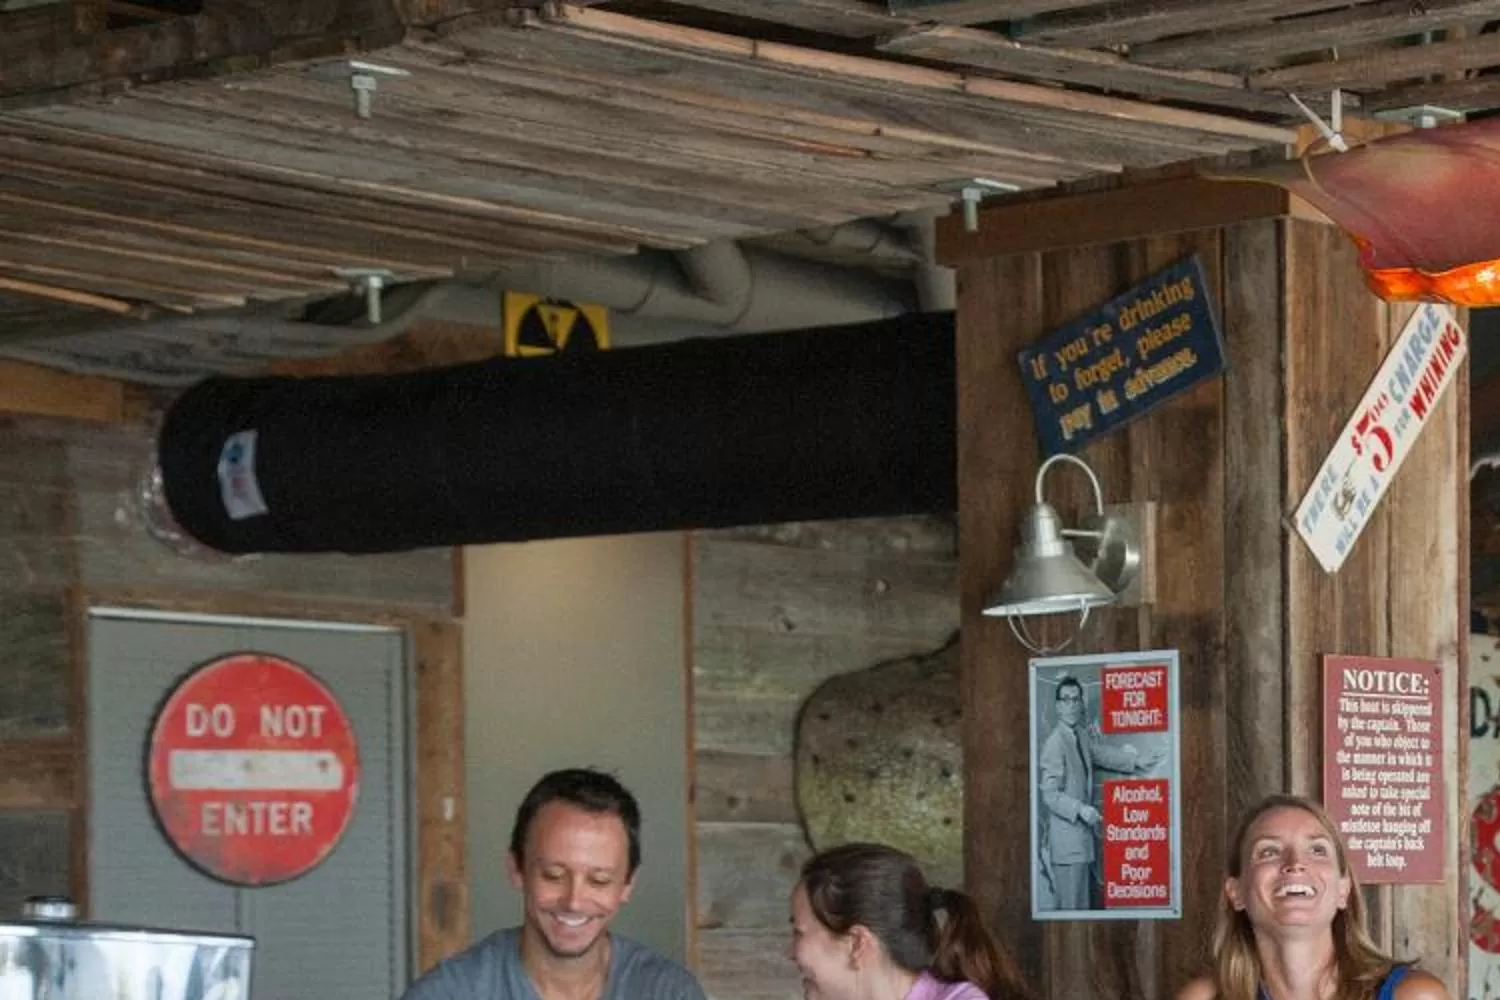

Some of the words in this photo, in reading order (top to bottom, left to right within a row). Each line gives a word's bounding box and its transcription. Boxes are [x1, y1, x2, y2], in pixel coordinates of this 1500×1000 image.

[1054, 323, 1113, 371] you're
[1119, 276, 1195, 331] drinking
[1049, 383, 1069, 403] to
[1073, 348, 1131, 390] forget,
[1136, 313, 1192, 360] please
[1388, 304, 1440, 405] CHARGE
[1409, 321, 1461, 421] WHINING
[1060, 402, 1092, 440] pay
[1096, 389, 1120, 414] in
[1303, 463, 1338, 535] THERE
[1105, 671, 1162, 689] FORECAST
[1343, 668, 1430, 695] NOTICE:
[1123, 690, 1146, 707] FOR
[1338, 698, 1358, 713] This
[1382, 701, 1390, 714] is
[186, 703, 236, 738] DO
[260, 704, 328, 738] NOT
[1337, 714, 1348, 732] by
[1351, 715, 1365, 730] the
[1406, 718, 1431, 733] Those
[1344, 732, 1354, 747] of
[1355, 735, 1372, 750] you
[1374, 734, 1392, 748] who
[1394, 735, 1419, 751] object
[1420, 738, 1431, 750] to
[1336, 750, 1351, 764] the
[1388, 752, 1397, 765] in
[1398, 752, 1423, 765] which
[1352, 767, 1377, 785] being
[1378, 768, 1415, 785] operated
[1124, 807, 1148, 823] Low
[1351, 803, 1370, 816] note
[1372, 801, 1382, 816] of
[1383, 801, 1397, 817] the
[1412, 802, 1424, 817] of
[202, 801, 315, 837] ENTER
[1382, 818, 1418, 837] hanging
[1418, 819, 1432, 834] off
[1107, 824, 1166, 842] Standards
[1125, 844, 1149, 860] and
[1347, 836, 1363, 850] the
[1404, 836, 1425, 851] back
[1121, 864, 1152, 881] Poor
[1108, 882, 1166, 899] Decisions
